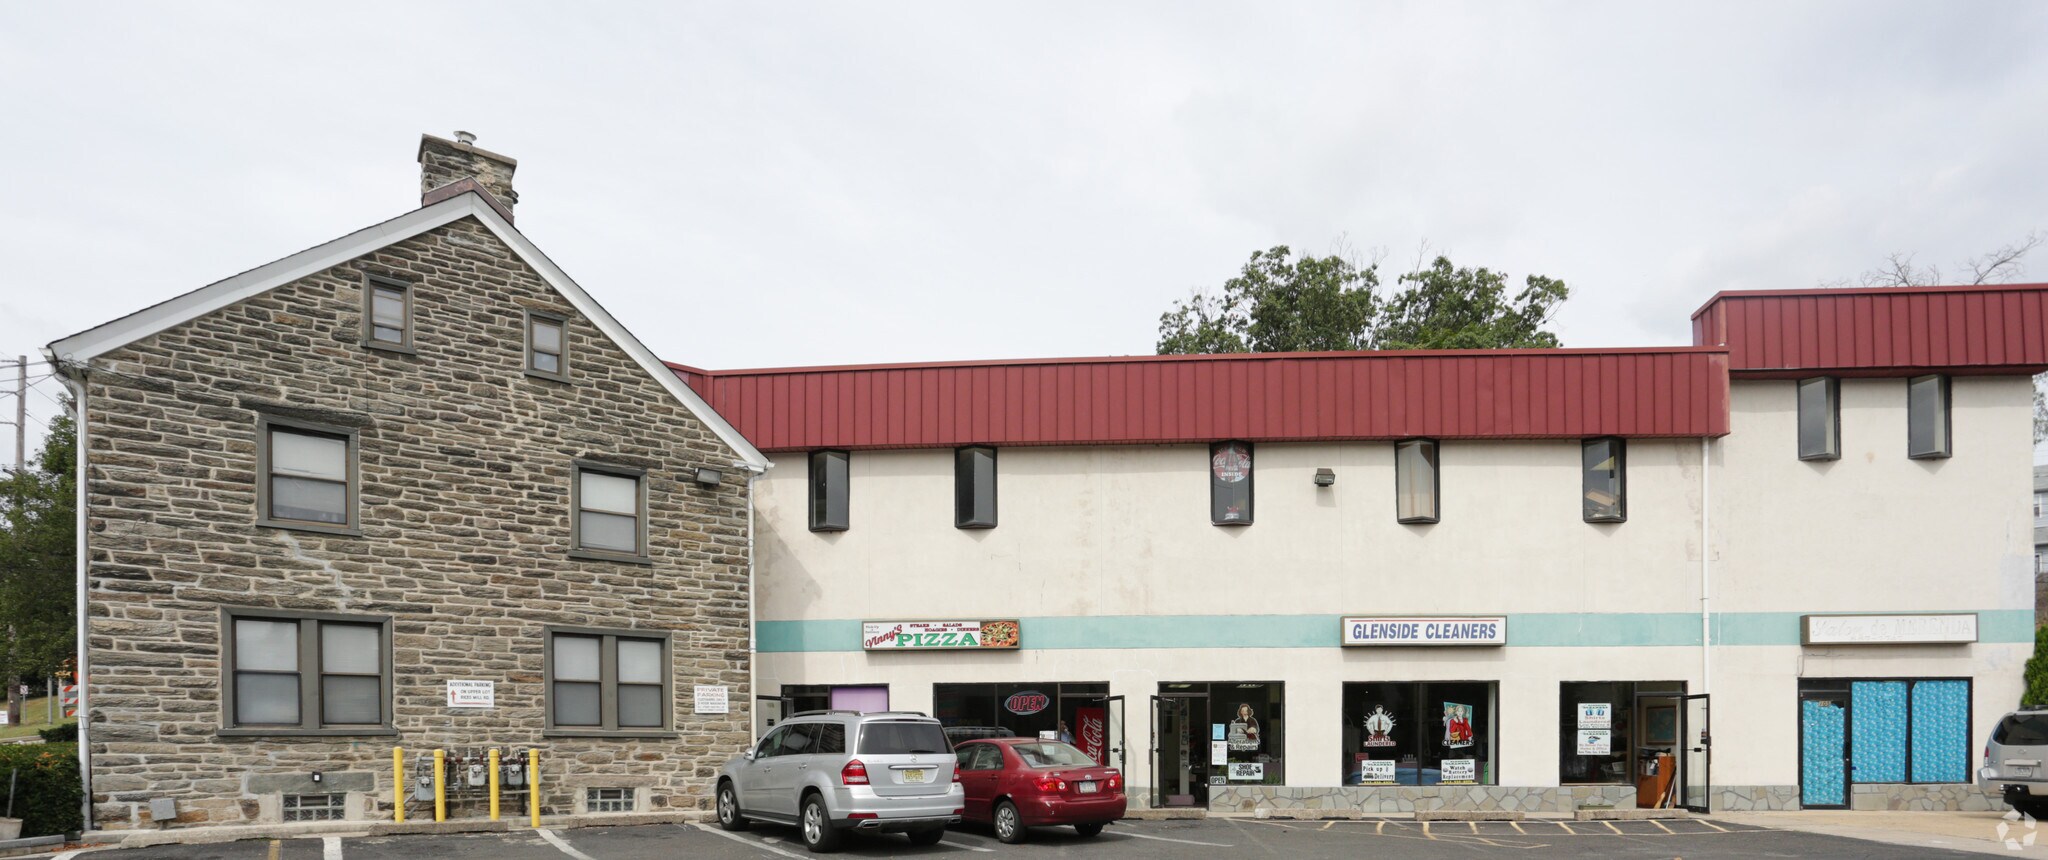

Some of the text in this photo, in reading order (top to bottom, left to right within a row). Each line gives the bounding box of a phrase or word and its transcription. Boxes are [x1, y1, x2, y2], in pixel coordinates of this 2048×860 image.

[1353, 623, 1497, 640] GLENSIDE CLEANERS
[895, 633, 979, 647] PIZZA
[1010, 695, 1045, 711] OPEN
[1210, 776, 1225, 784] OPEN
